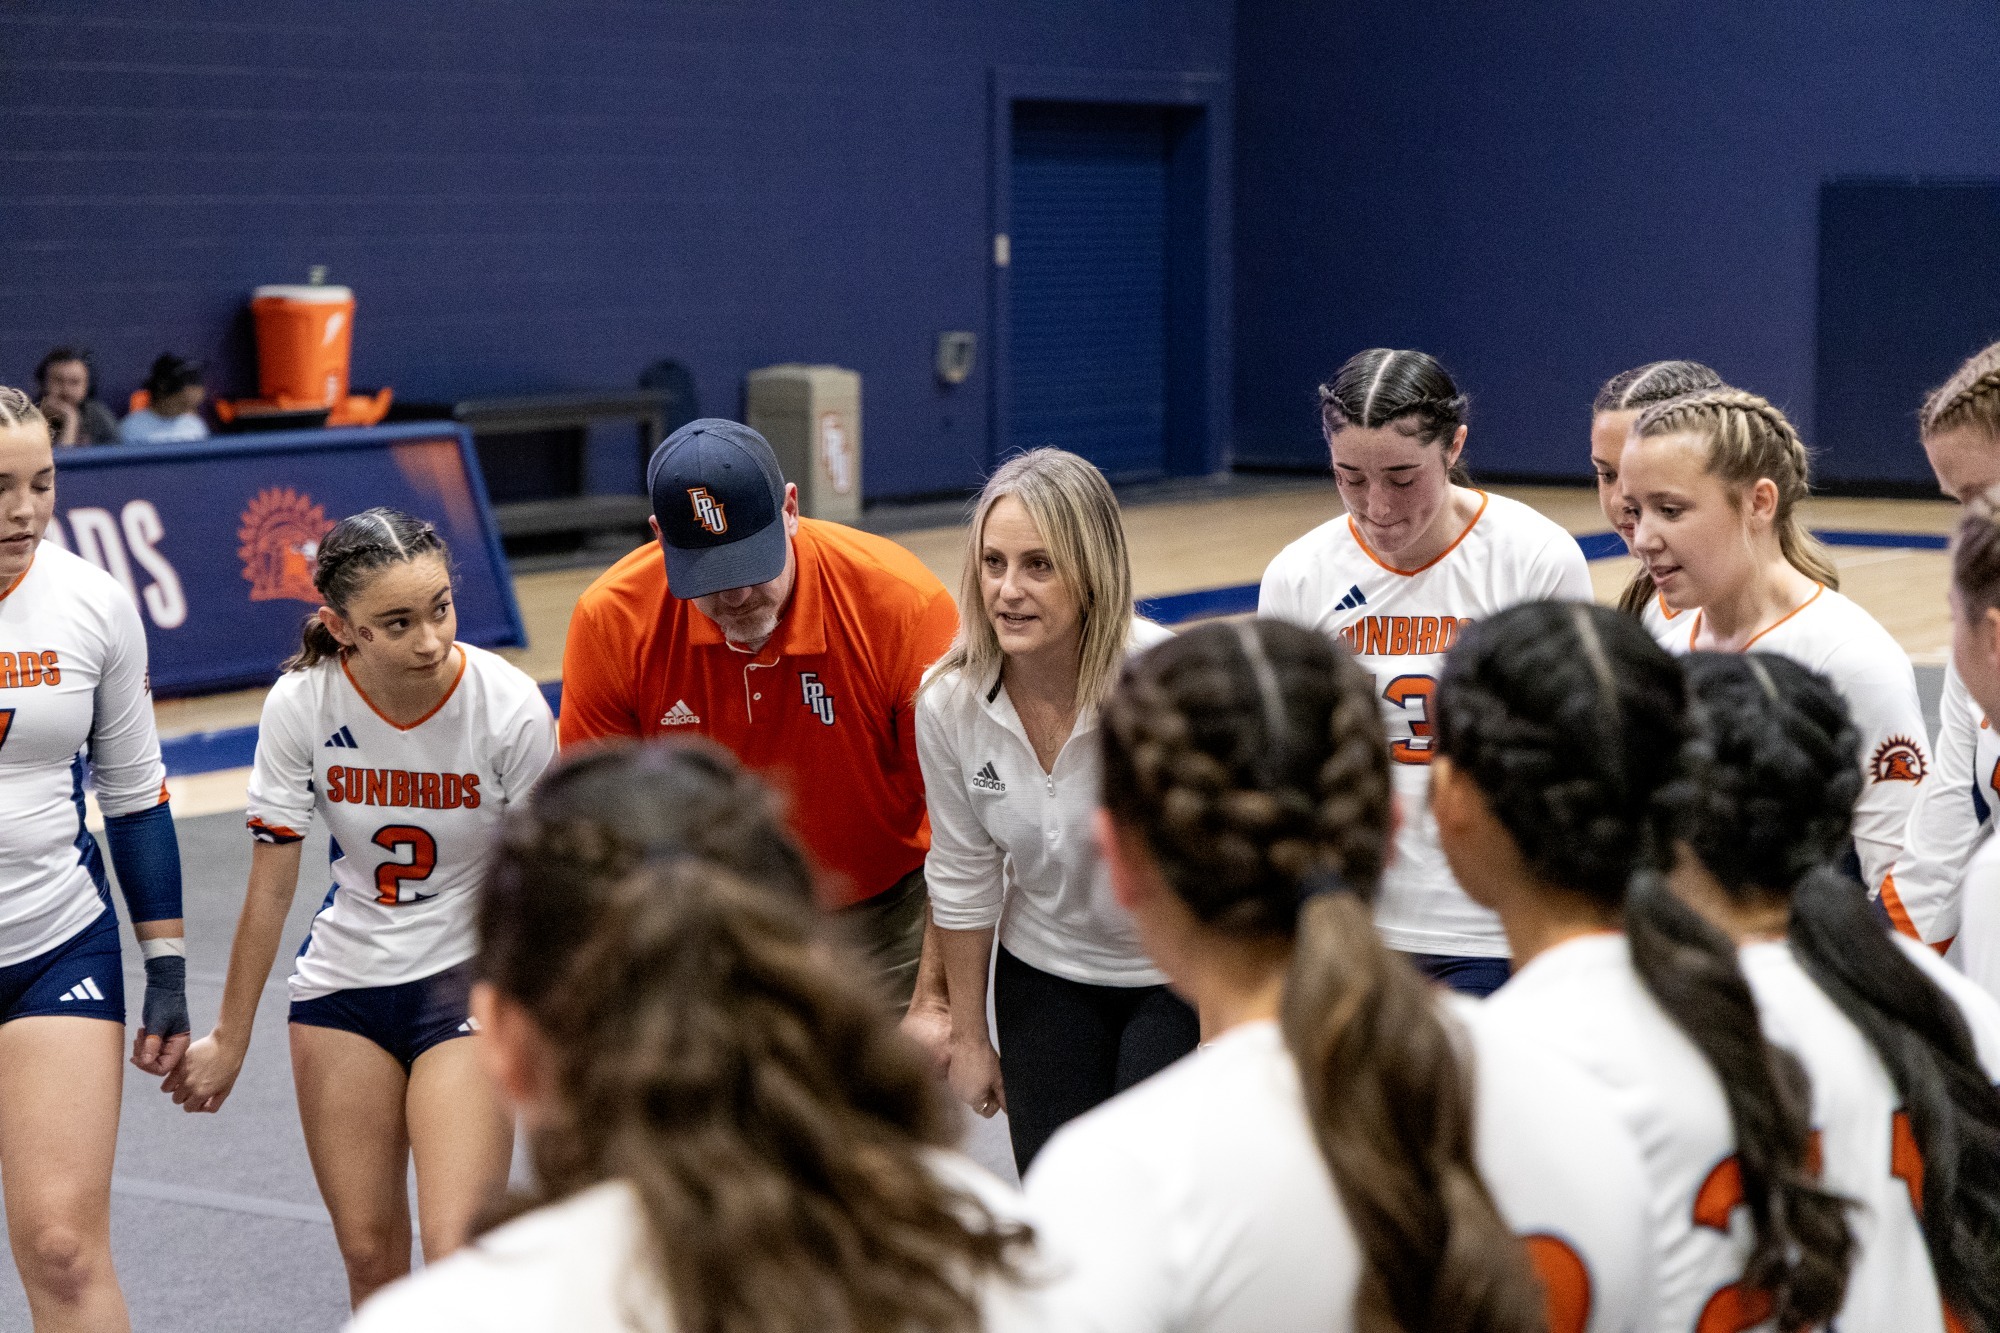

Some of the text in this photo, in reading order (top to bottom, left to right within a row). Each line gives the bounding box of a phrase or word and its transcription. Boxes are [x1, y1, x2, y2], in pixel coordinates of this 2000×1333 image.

[45, 499, 188, 630] DS
[1339, 615, 1475, 656] UNBIRD
[660, 713, 701, 726] adidas
[798, 672, 836, 727] FPU
[1370, 673, 1443, 766] 3
[326, 764, 482, 810] SUNBIRDS
[972, 777, 1006, 792] adidas
[370, 823, 438, 907] 2
